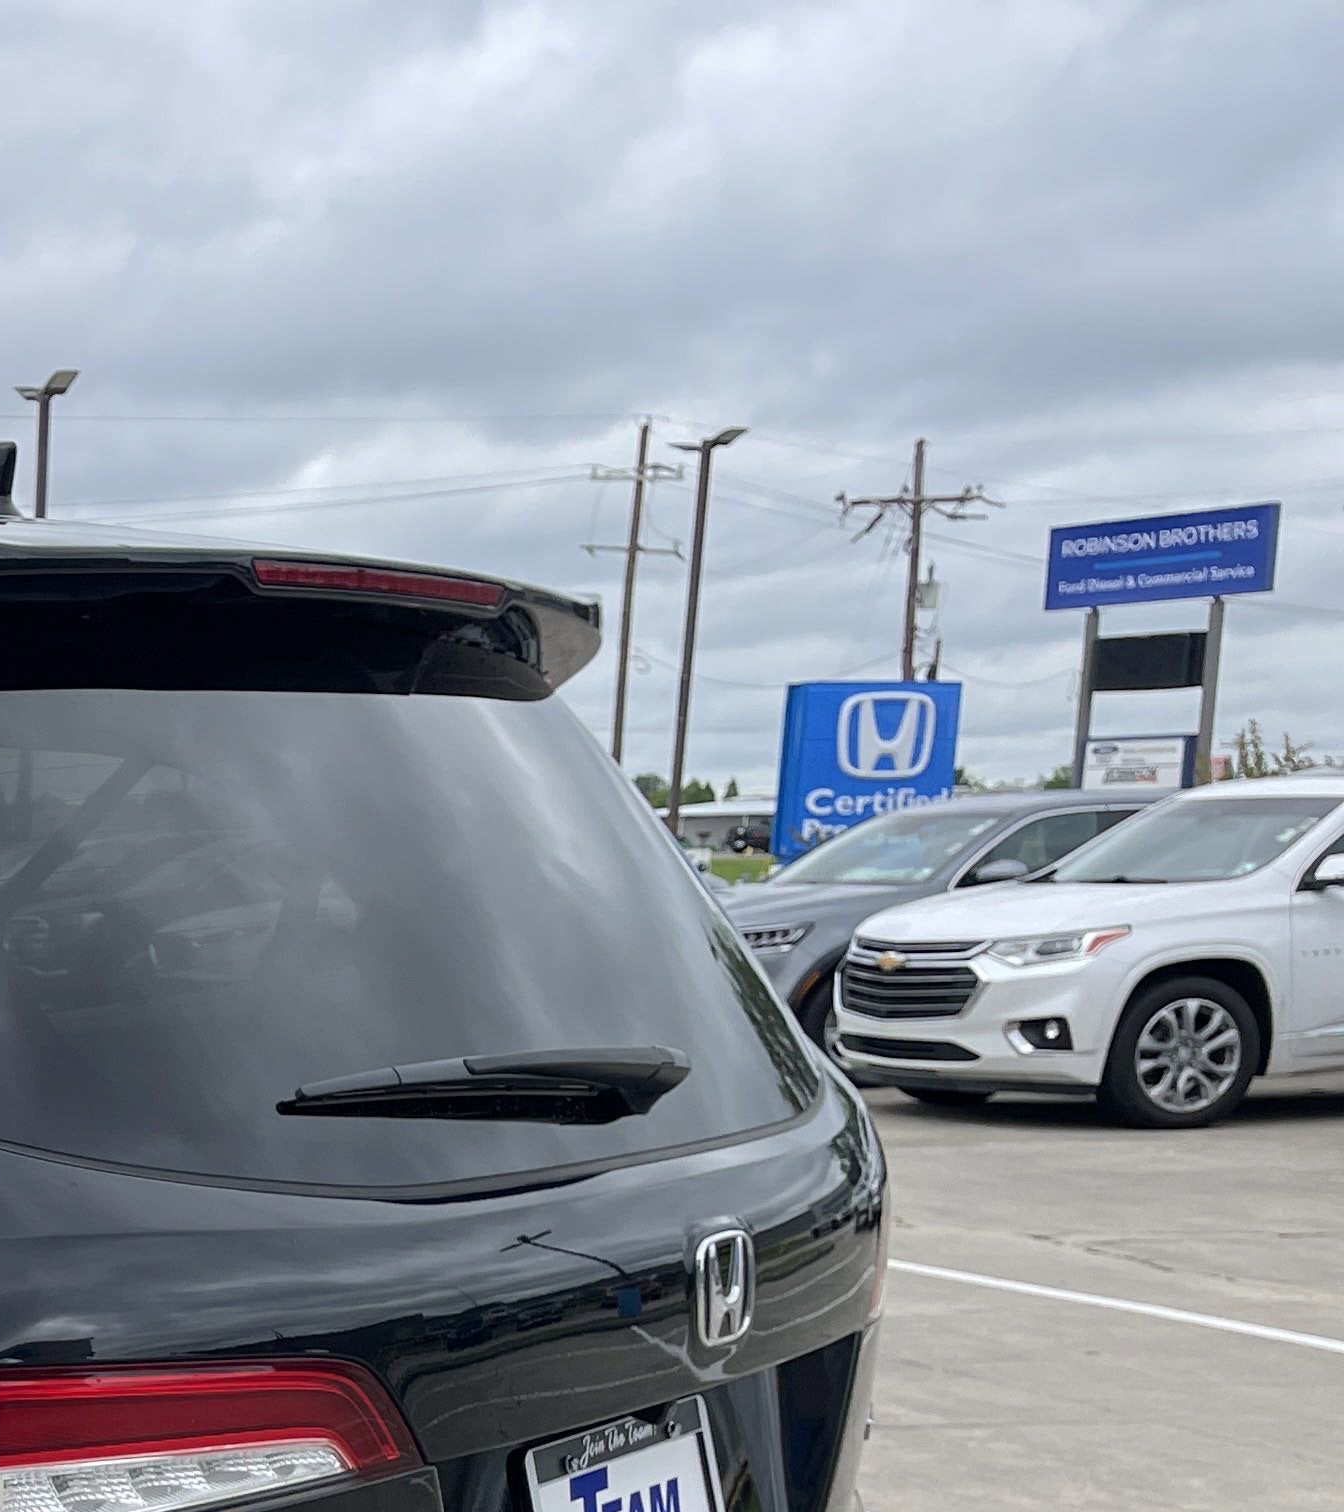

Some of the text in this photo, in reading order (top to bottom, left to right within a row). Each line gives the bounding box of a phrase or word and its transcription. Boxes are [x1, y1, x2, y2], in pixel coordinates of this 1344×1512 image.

[1061, 519, 1259, 558] ROBINSON BROTHERS
[1087, 575, 1124, 592] Diesel
[1126, 575, 1136, 590] &
[1137, 567, 1208, 588] Commercial
[1209, 564, 1256, 582] Service
[580, 1434, 605, 1468] Join
[605, 1426, 625, 1452] The
